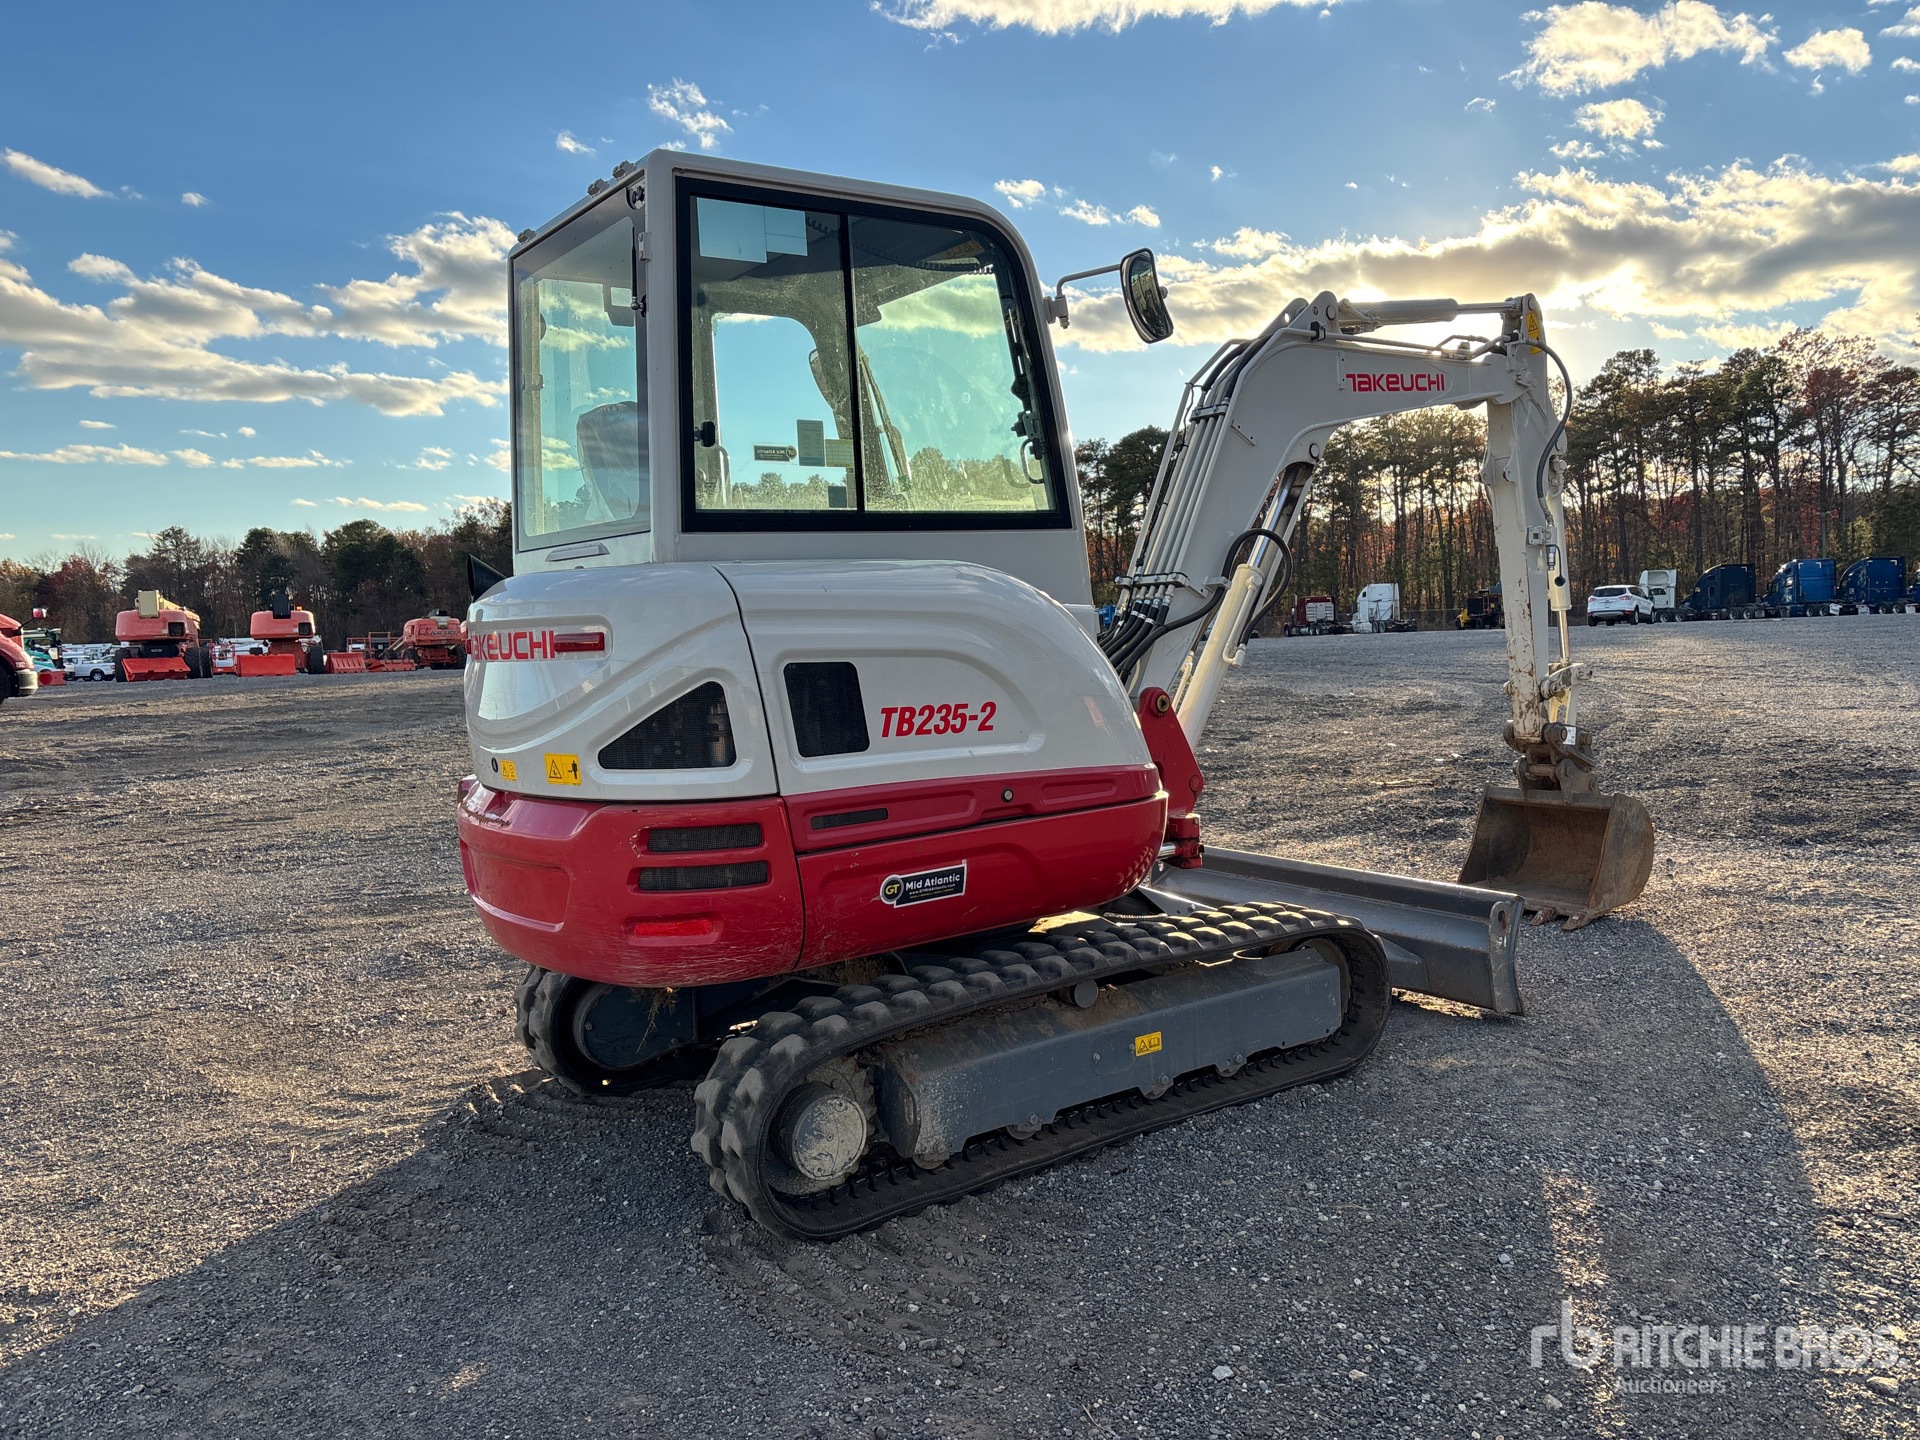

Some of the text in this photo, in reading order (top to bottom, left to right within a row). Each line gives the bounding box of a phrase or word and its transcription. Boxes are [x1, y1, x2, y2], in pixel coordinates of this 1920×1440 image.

[1345, 373, 1445, 392] TAKEUCHI
[470, 630, 555, 660] AKEUCHI
[880, 701, 997, 738] TB235-2
[885, 884, 900, 895] GT
[905, 873, 961, 891] Mid Atlantic
